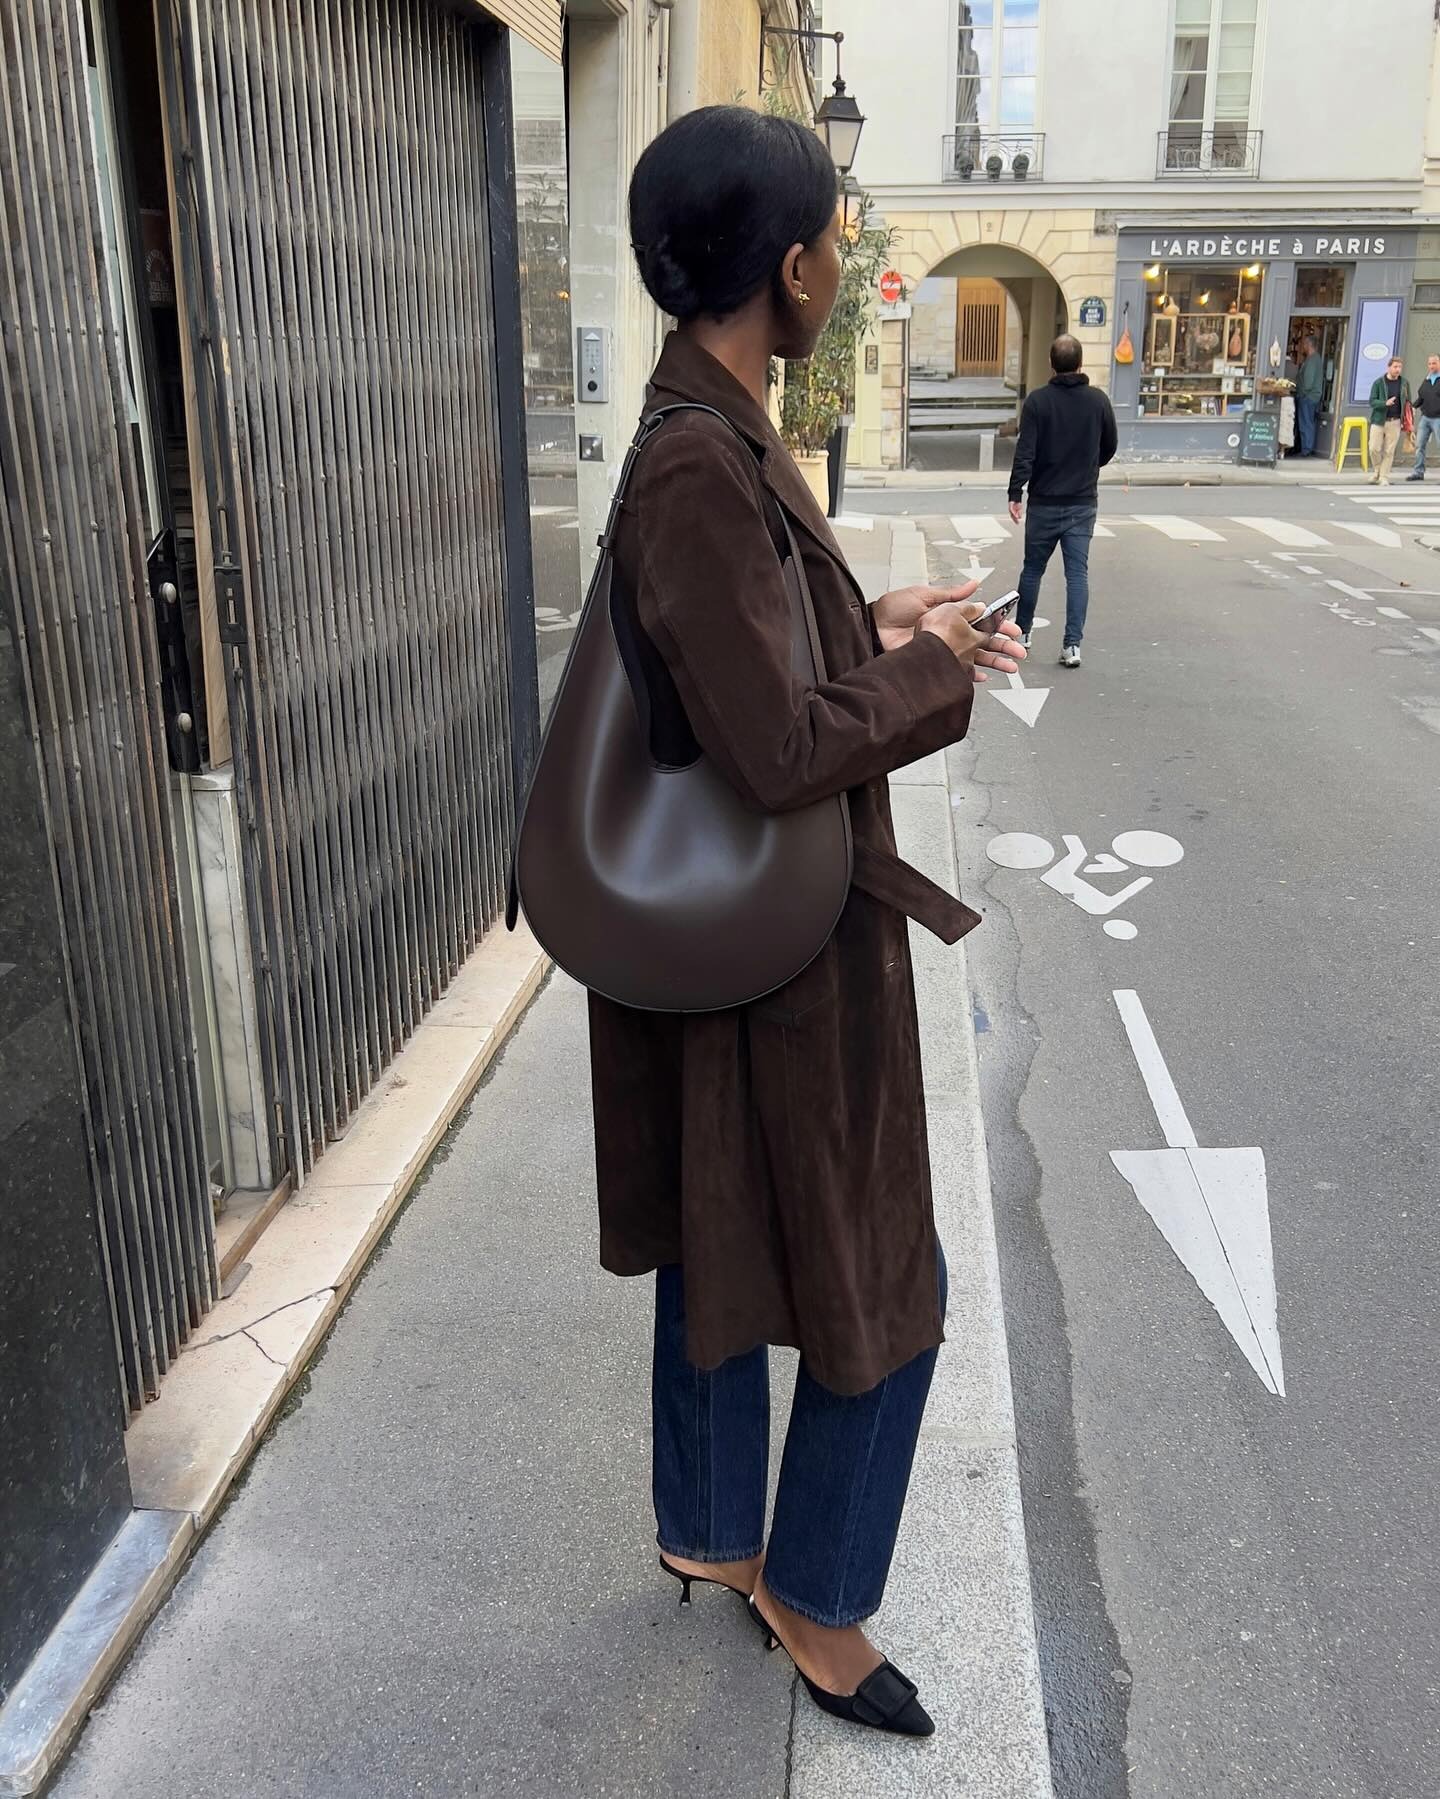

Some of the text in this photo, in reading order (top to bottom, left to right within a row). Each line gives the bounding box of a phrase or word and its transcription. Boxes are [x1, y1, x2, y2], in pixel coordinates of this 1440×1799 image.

[1151, 235, 1385, 256] L'ARDÈCHE à PARIS
